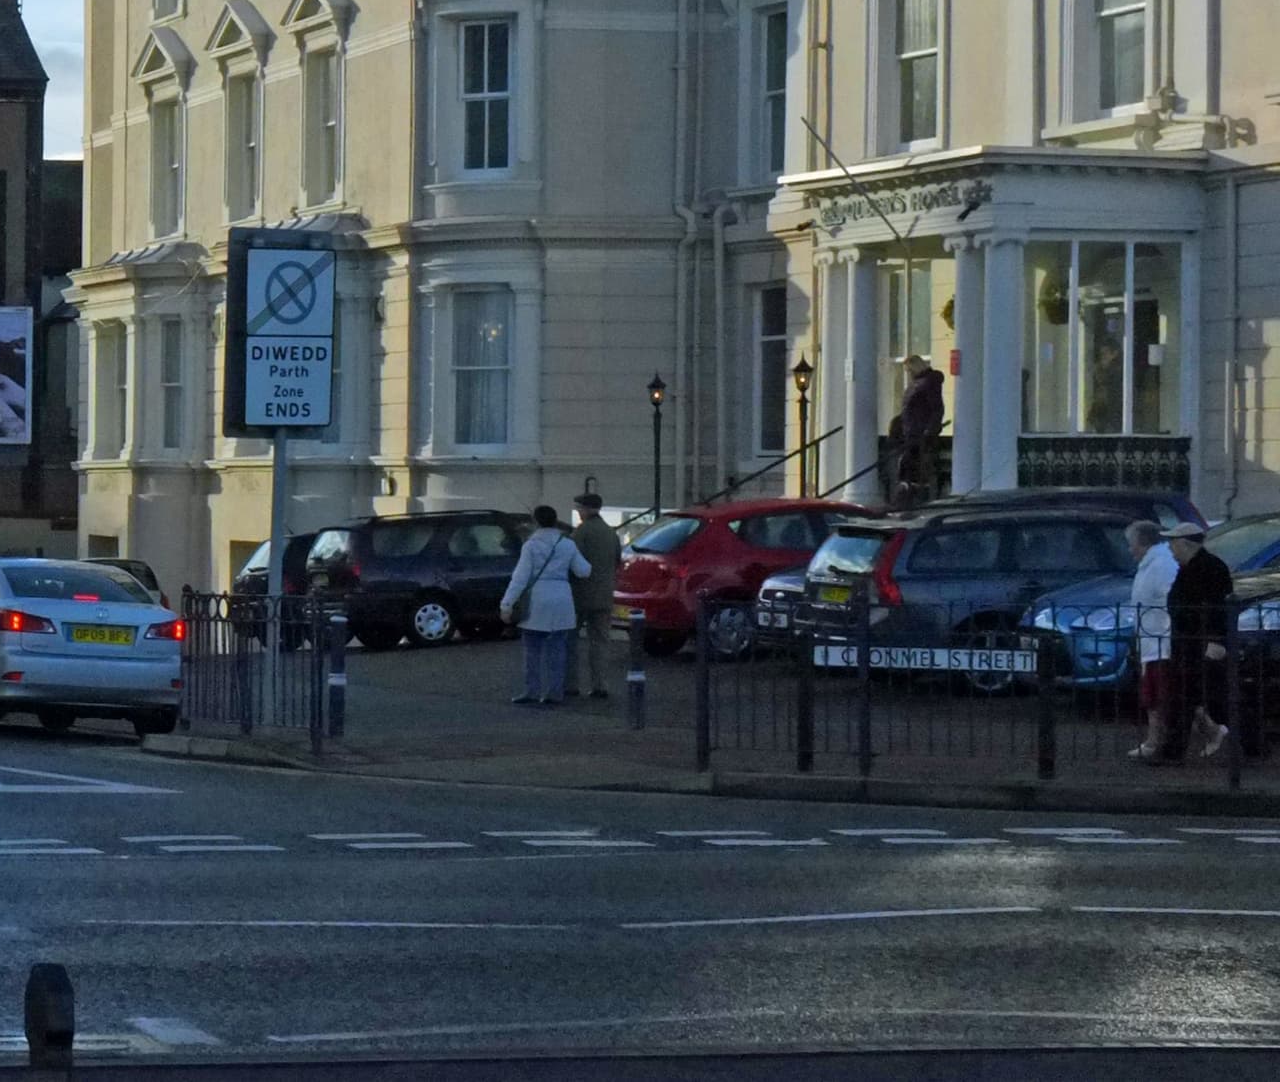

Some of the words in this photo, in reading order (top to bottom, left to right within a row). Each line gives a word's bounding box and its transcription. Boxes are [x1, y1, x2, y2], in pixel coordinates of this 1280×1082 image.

[251, 345, 328, 361] DIWEDD
[269, 364, 309, 378] Parth
[273, 385, 304, 398] Zone
[264, 402, 311, 417] ENDS
[841, 648, 942, 667] CONMEL
[951, 650, 1032, 670] STREET
